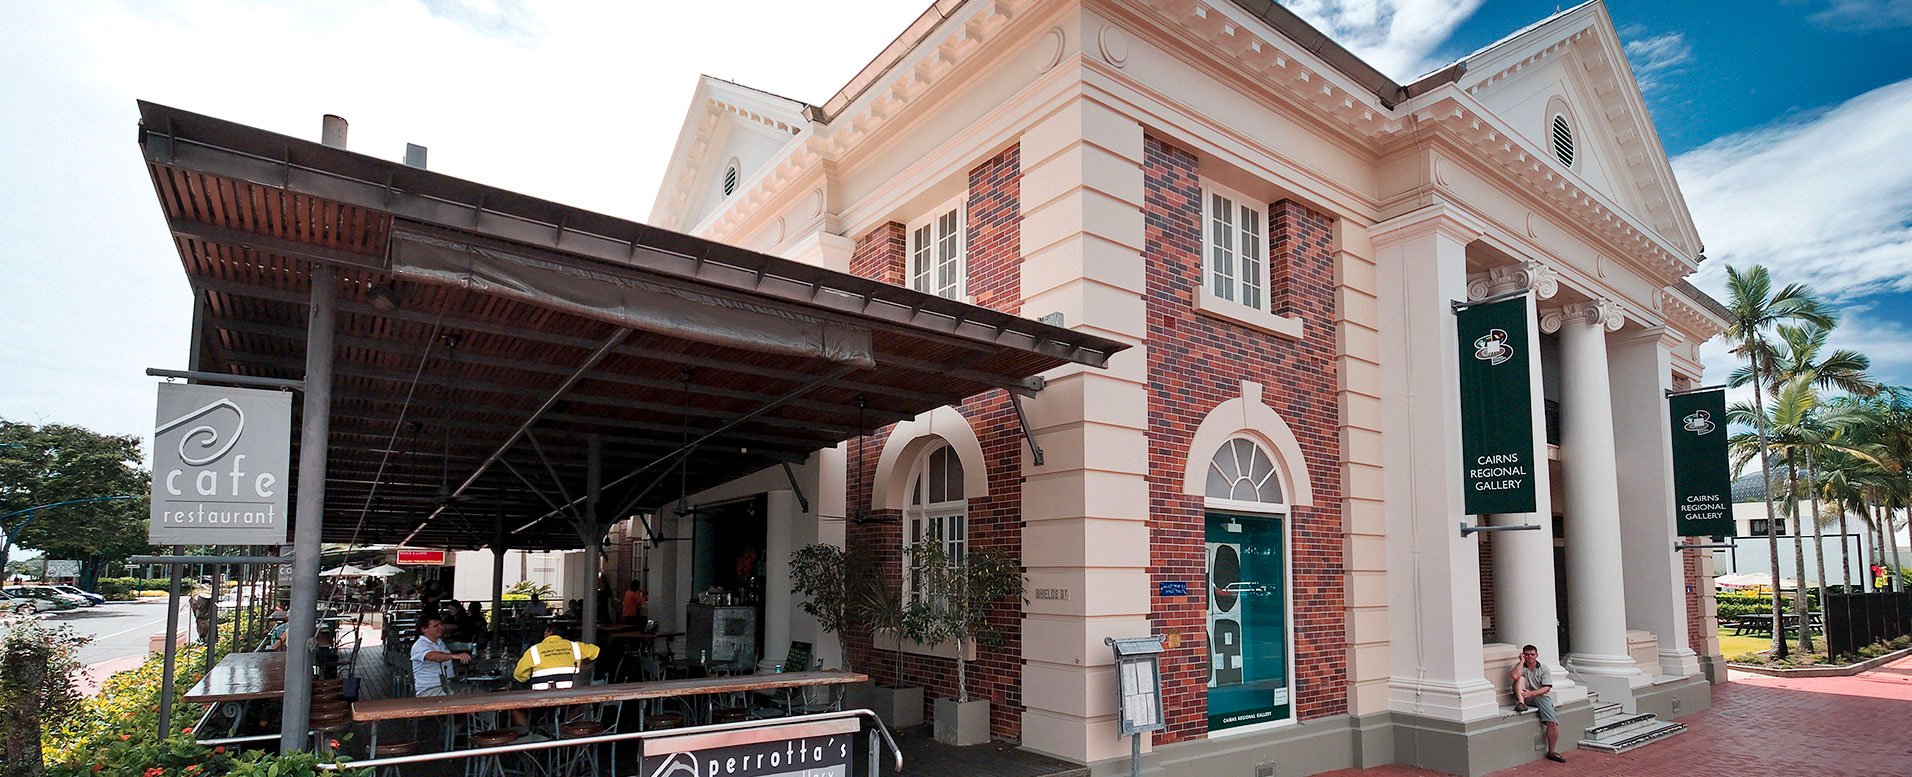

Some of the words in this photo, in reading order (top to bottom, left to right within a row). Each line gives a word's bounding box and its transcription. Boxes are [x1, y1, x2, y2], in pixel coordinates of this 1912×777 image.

[1477, 453, 1518, 465] CAIRNS
[166, 454, 276, 498] cafe
[1470, 466, 1527, 478] REGIONAL
[1475, 479, 1522, 491] GALLERY
[1686, 495, 1720, 503] CAIRNS
[1681, 503, 1726, 511] REGIONAL
[164, 504, 275, 523] restaurant
[1685, 512, 1723, 520] GALLERY
[709, 738, 847, 777] perrotta's
